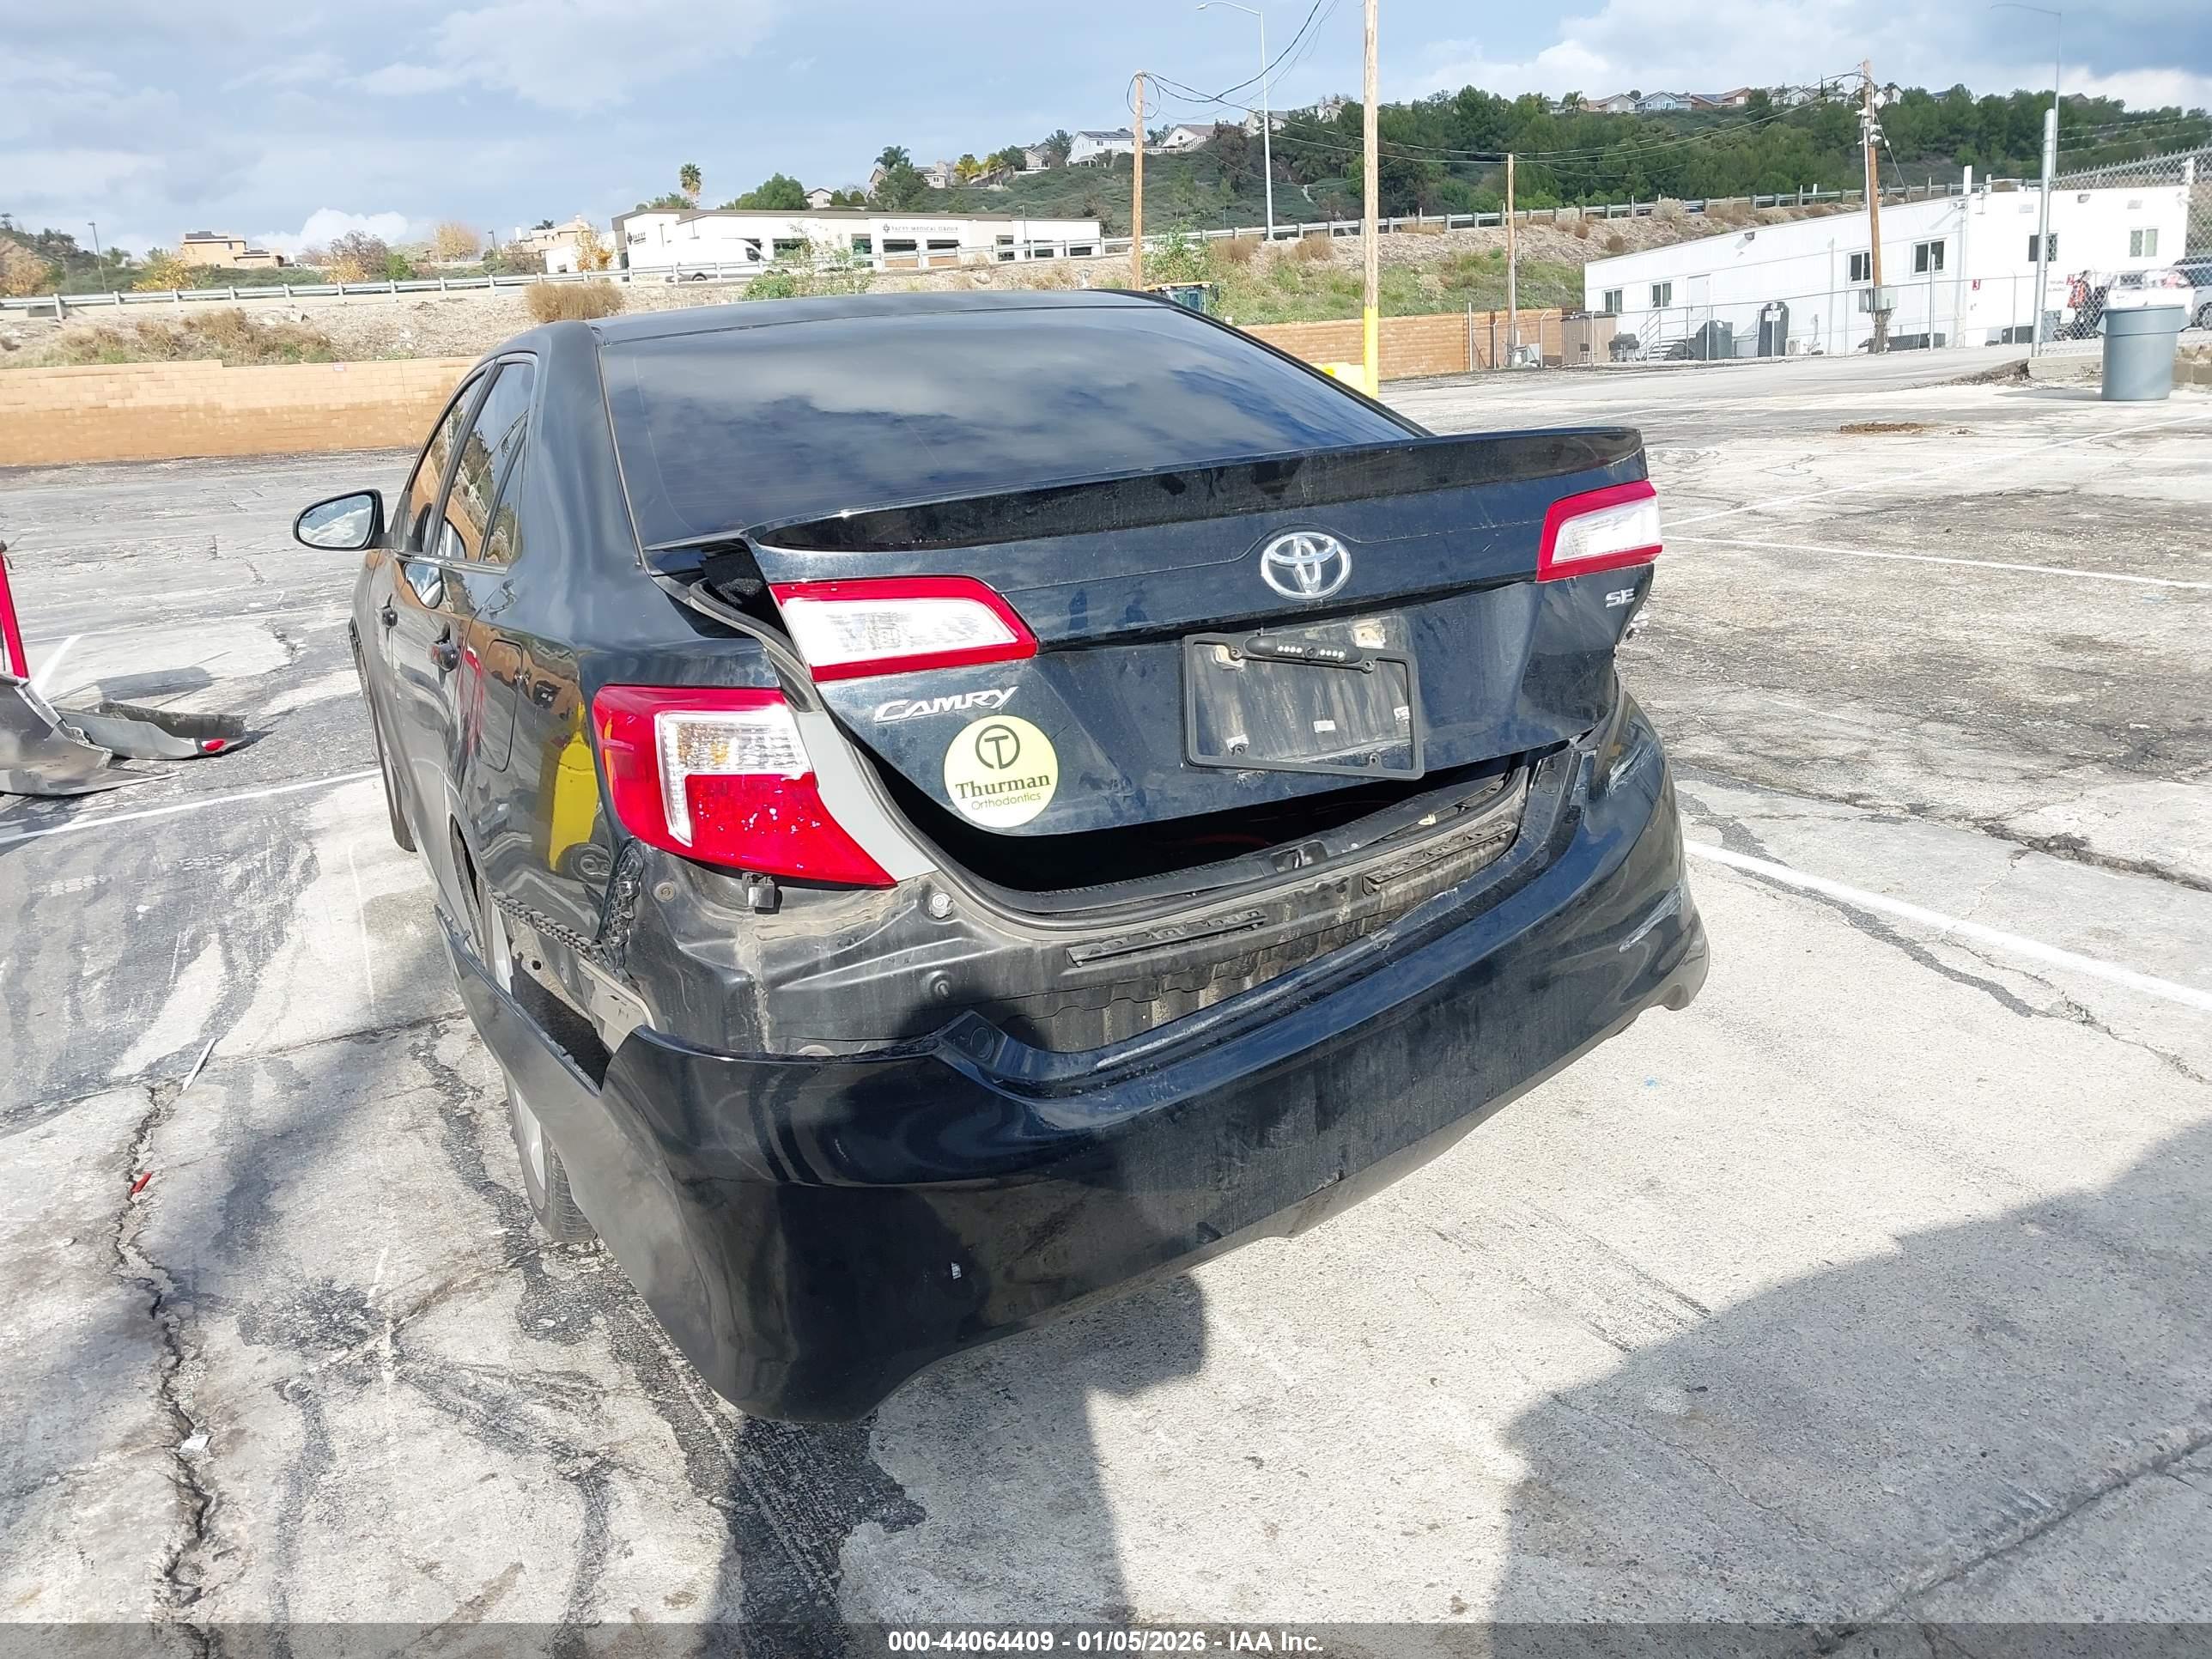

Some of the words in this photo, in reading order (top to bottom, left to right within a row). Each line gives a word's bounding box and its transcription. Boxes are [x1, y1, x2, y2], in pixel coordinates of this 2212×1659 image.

[1606, 587, 1636, 609] SE
[874, 686, 1019, 723] CAMRY
[955, 774, 1052, 800] Thurman
[971, 792, 1042, 811] Orthodontics
